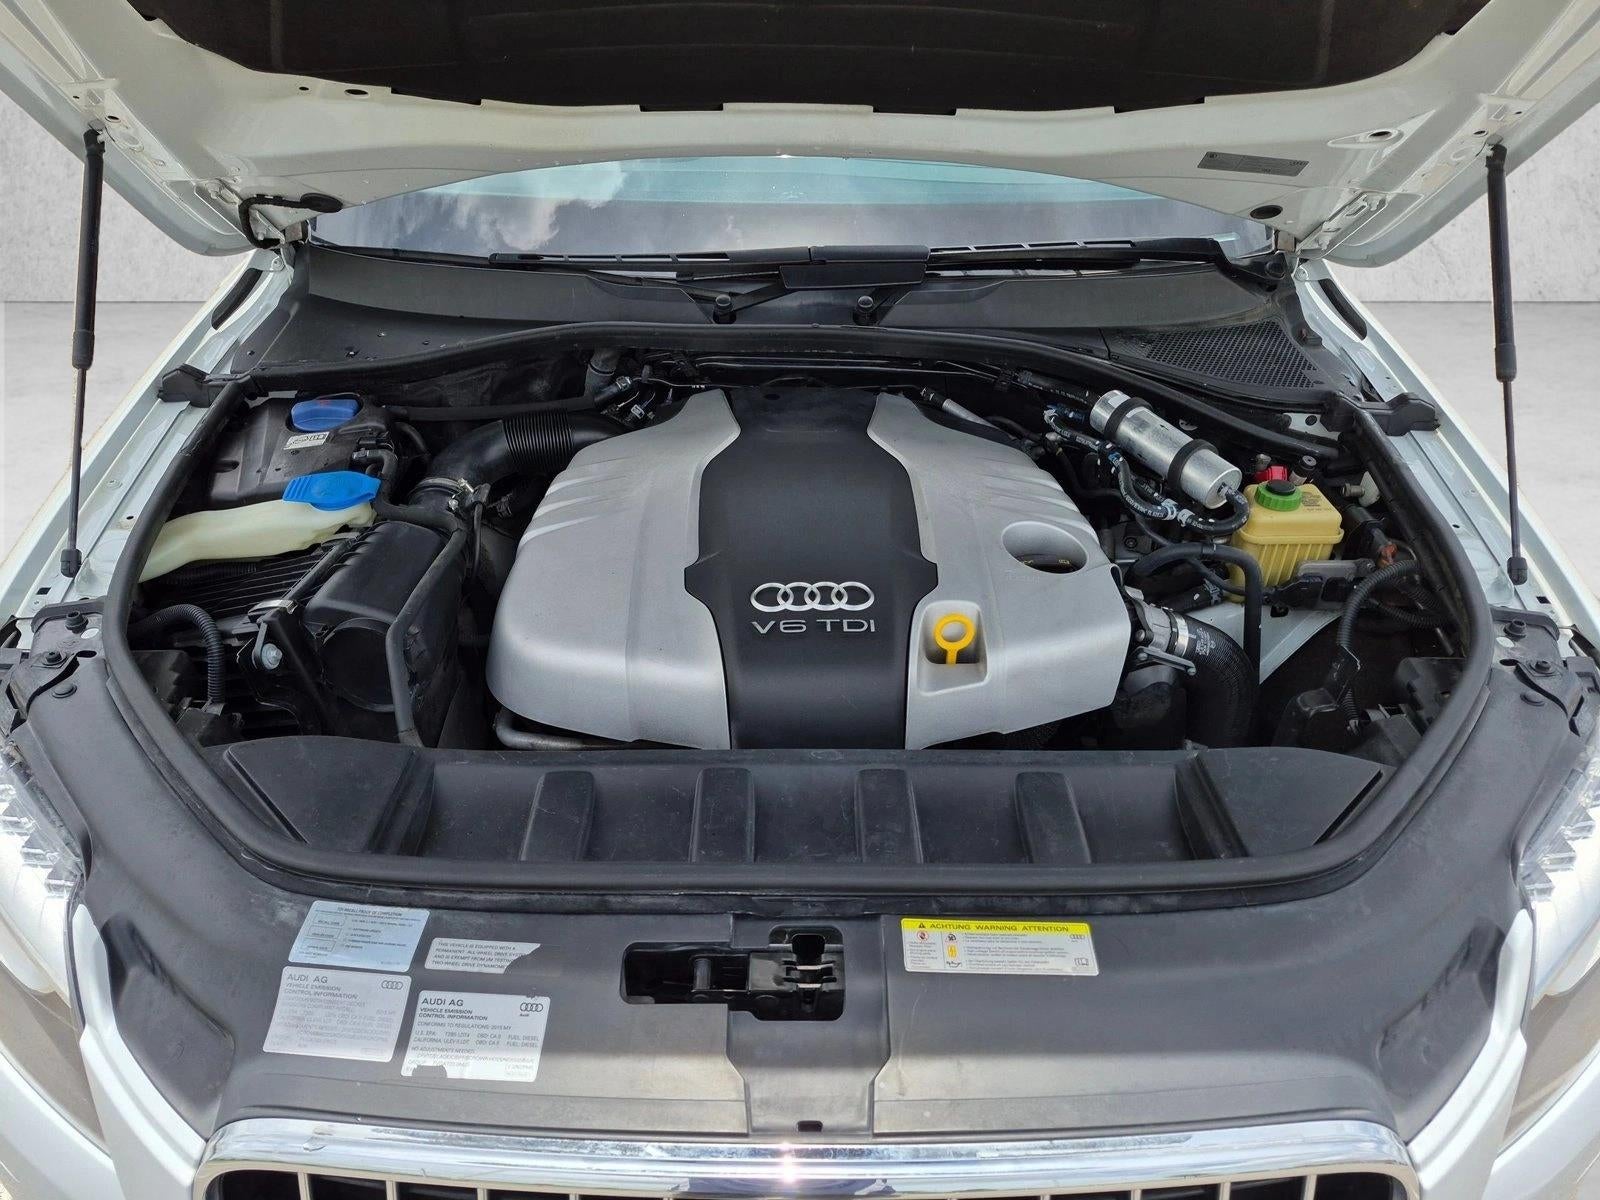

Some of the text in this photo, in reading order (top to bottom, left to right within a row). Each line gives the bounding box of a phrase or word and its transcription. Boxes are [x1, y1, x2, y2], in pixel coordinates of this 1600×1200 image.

[751, 619, 876, 634] V6 TDI
[287, 974, 328, 984] AUDI AG
[284, 988, 359, 999] CONTROL INFORMATION
[422, 997, 446, 1005] AUDI
